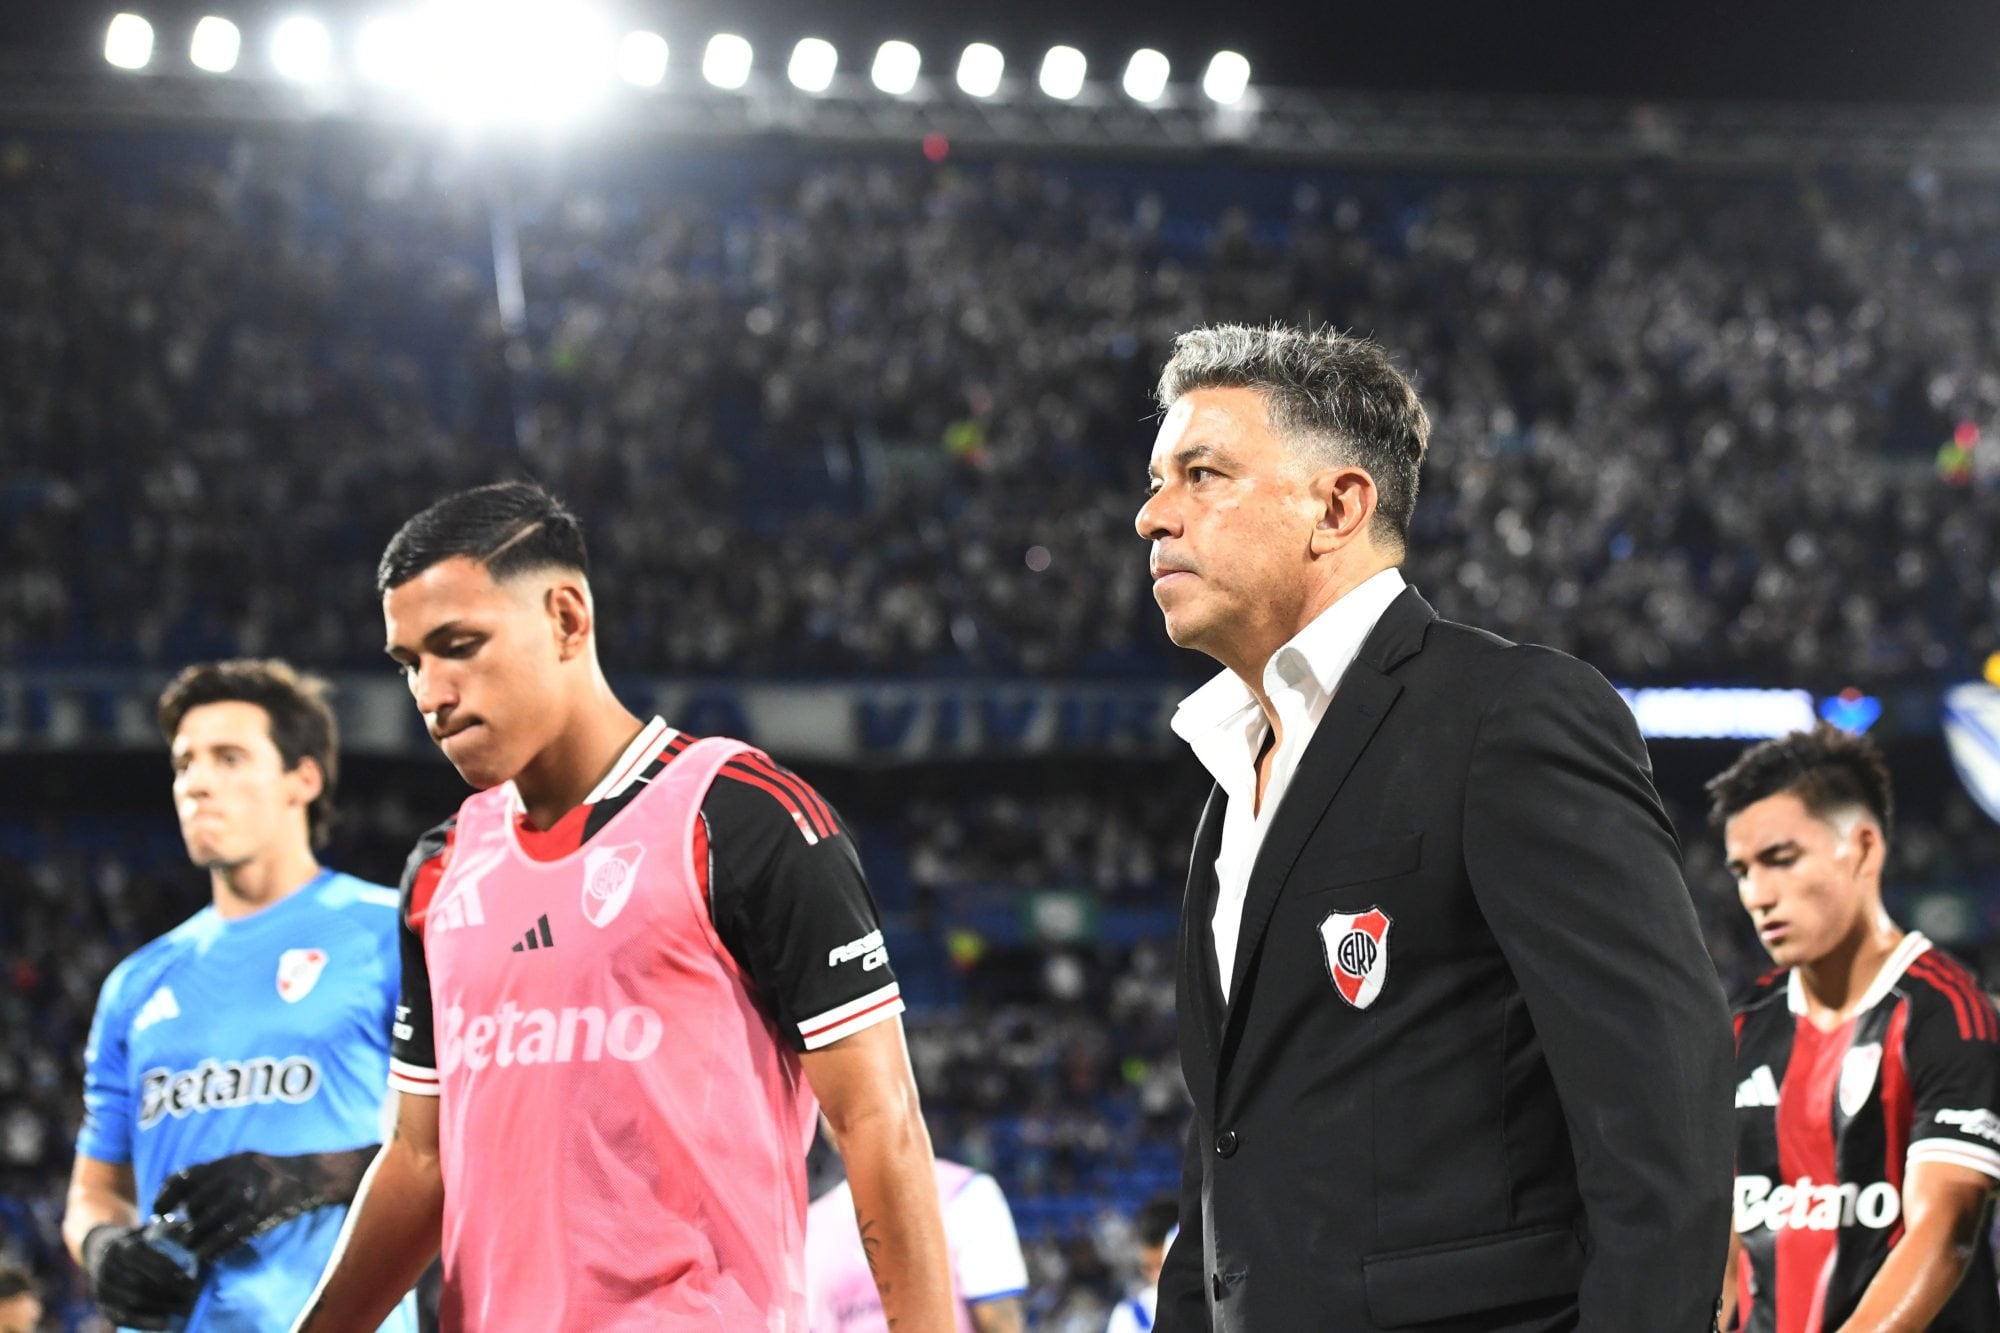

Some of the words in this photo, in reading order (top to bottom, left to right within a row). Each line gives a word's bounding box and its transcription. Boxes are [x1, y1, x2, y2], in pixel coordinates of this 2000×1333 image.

[441, 1001, 663, 1078] Betano
[139, 1057, 320, 1130] Betano
[1734, 1175, 1900, 1233] Betano
